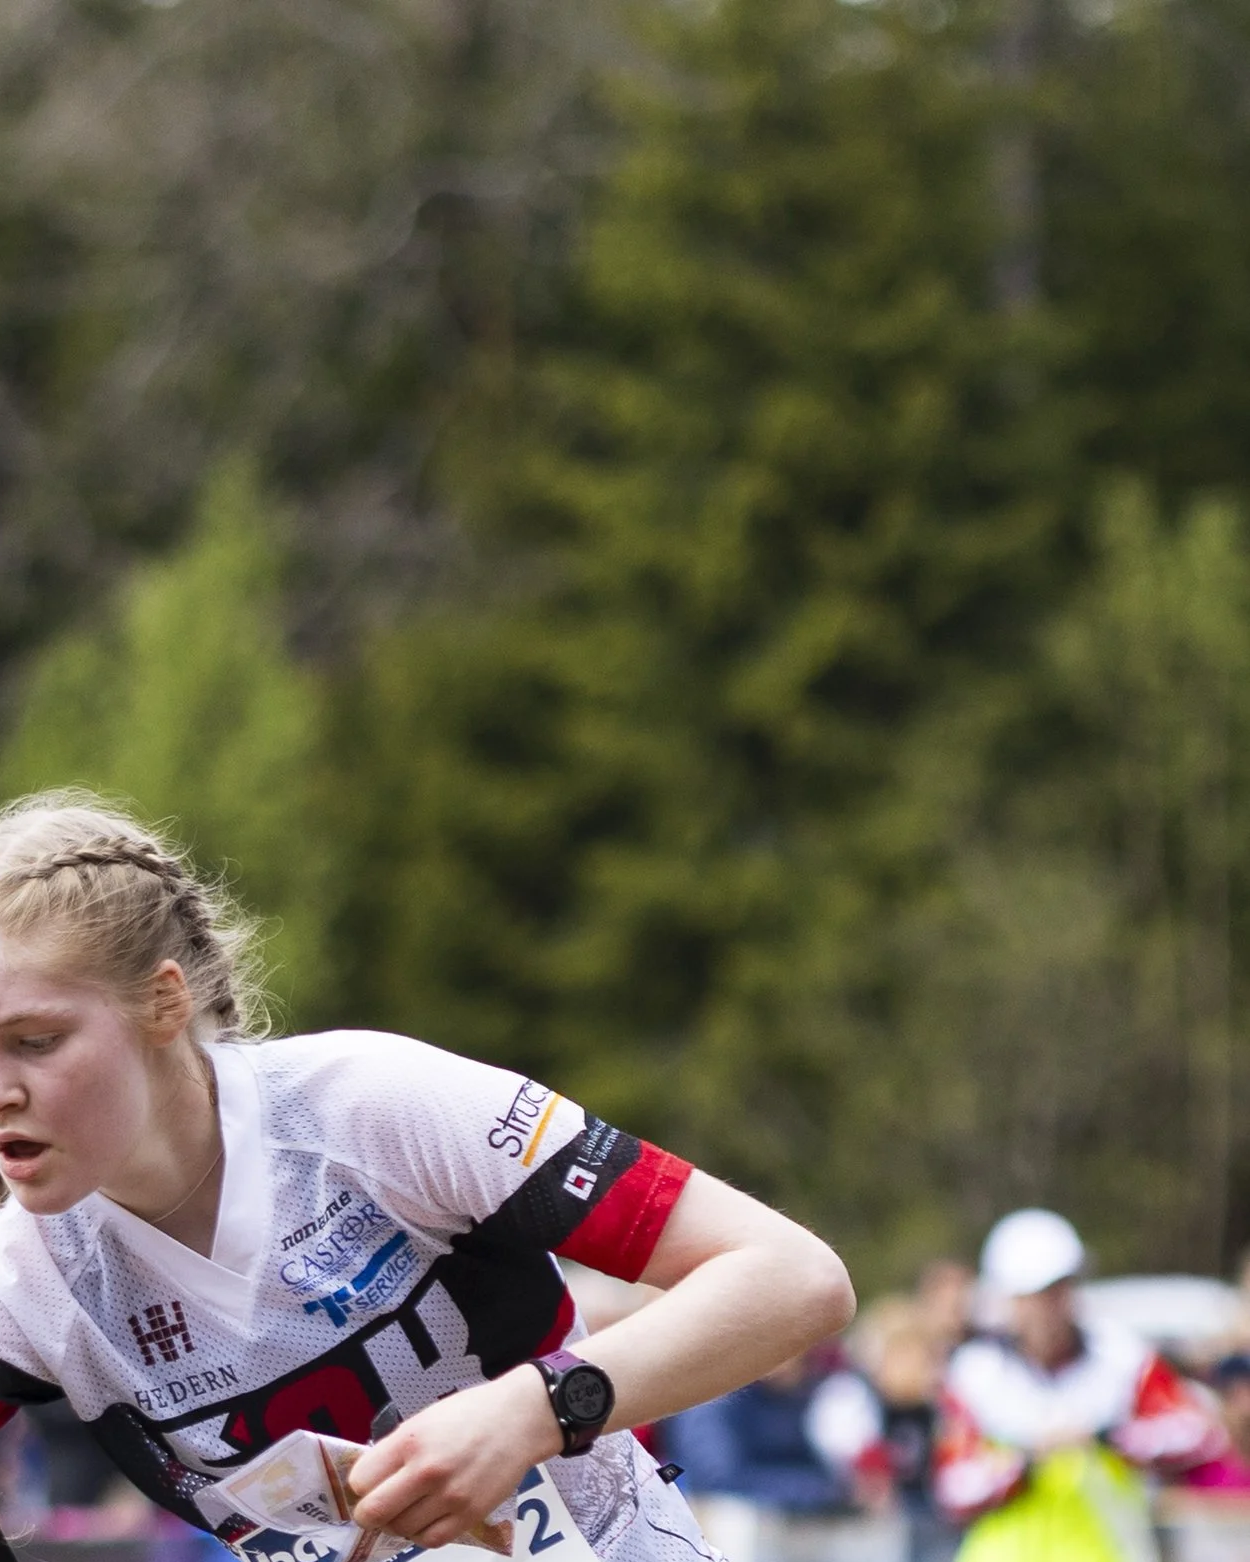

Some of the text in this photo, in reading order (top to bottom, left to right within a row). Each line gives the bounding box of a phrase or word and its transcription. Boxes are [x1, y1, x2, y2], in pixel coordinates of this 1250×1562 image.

[280, 1190, 353, 1253] noname
[354, 1243, 420, 1311] SERVICE
[134, 1363, 241, 1412] HEDERN
